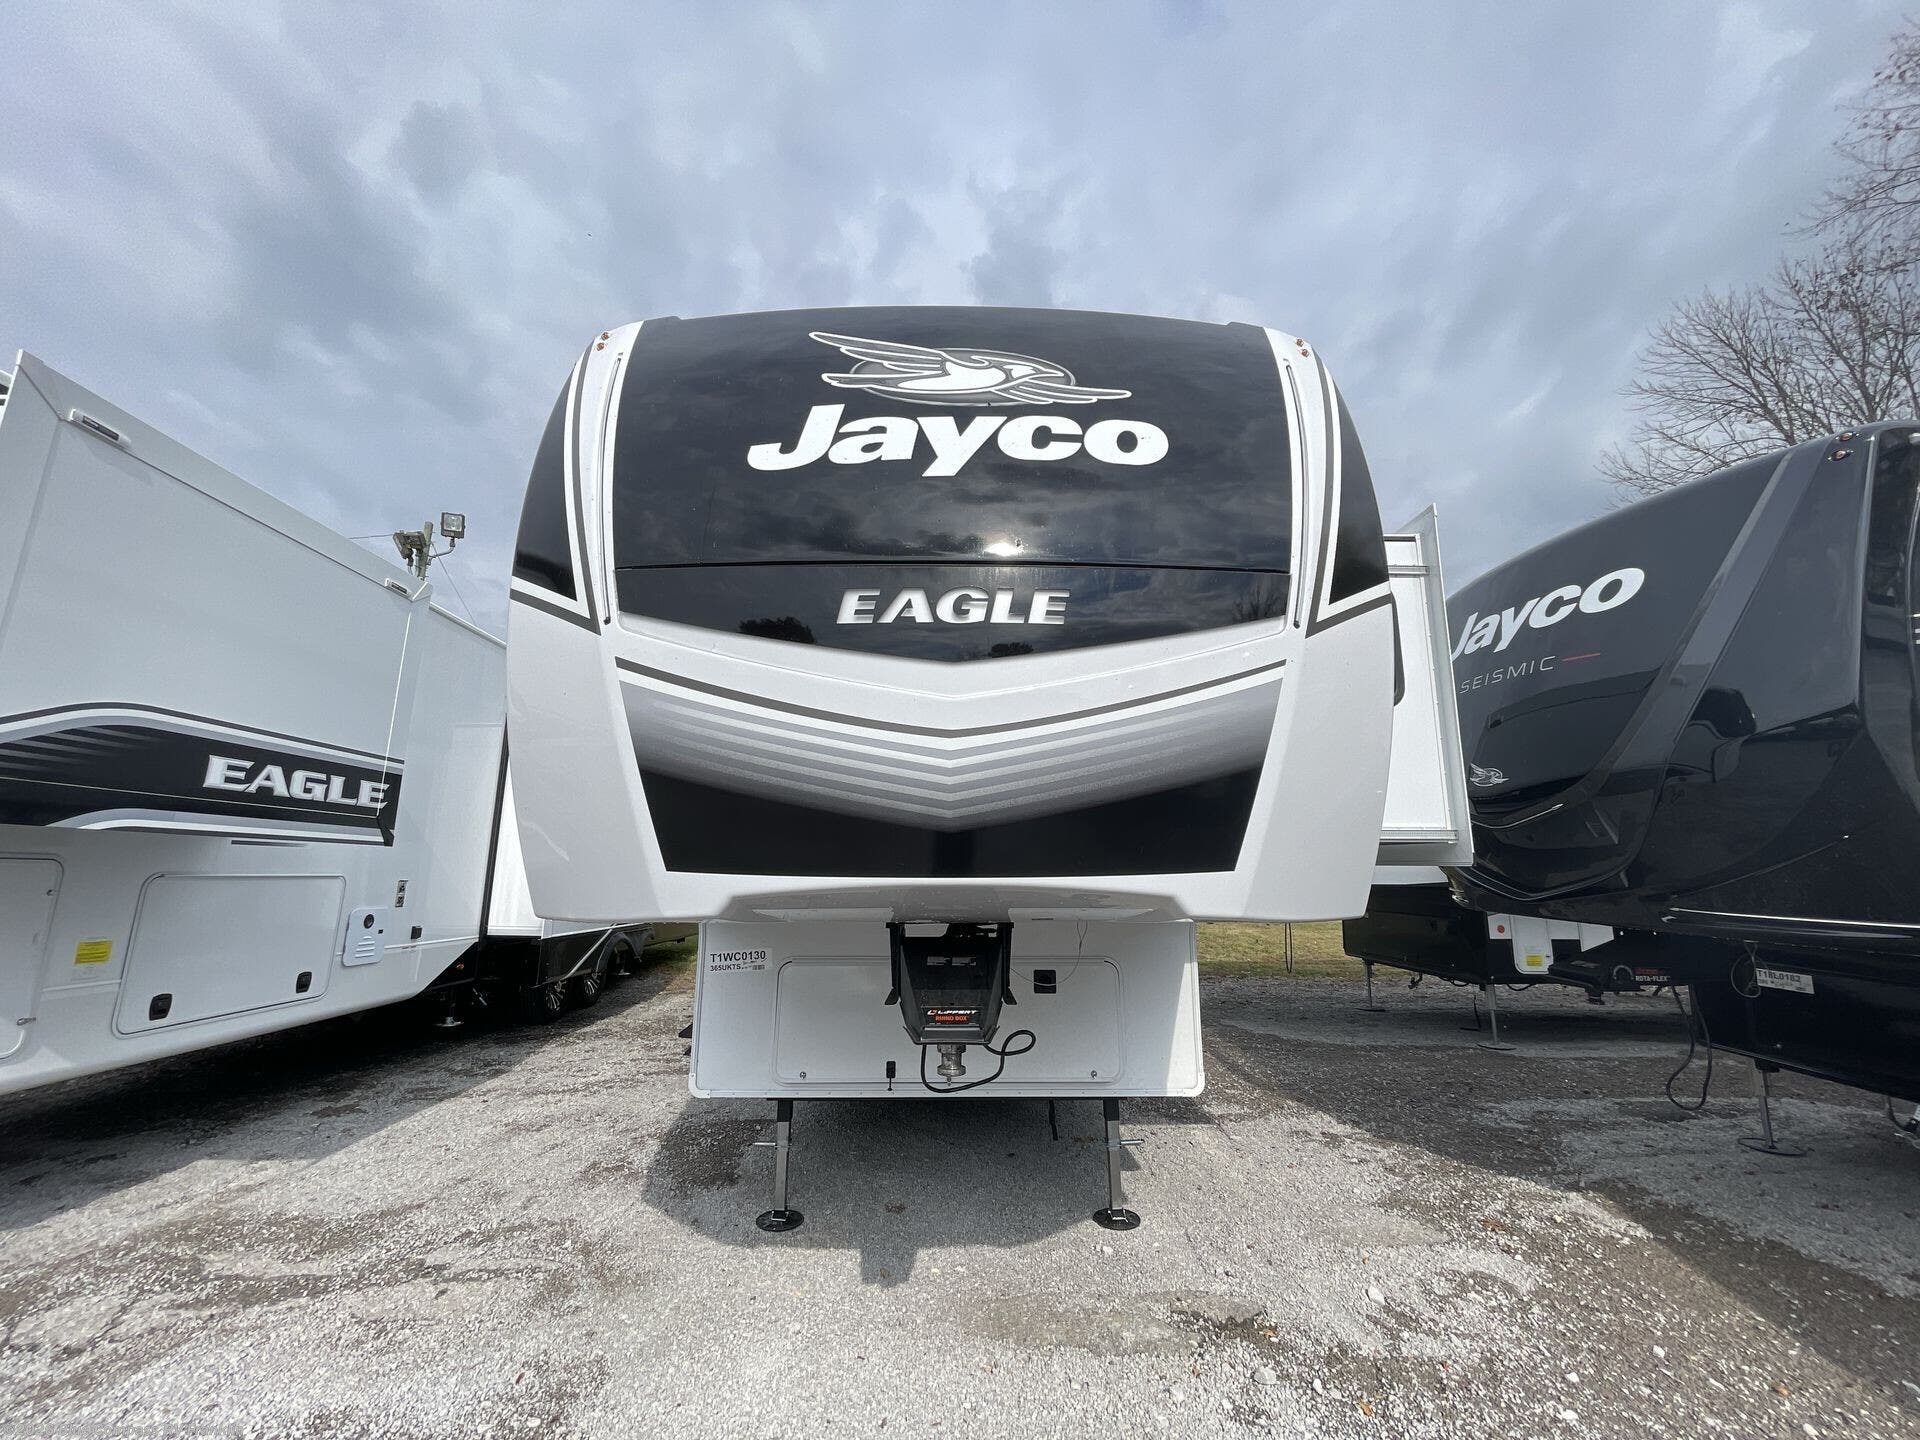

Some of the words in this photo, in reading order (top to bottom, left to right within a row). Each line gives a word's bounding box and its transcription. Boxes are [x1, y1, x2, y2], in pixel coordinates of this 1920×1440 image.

[747, 404, 1169, 477] Jayco
[836, 588, 1070, 625] EAGLE
[1450, 567, 1645, 663] Jayco
[1459, 655, 1556, 694] SEISMIC
[202, 754, 390, 809] EAGLE
[710, 950, 766, 962] T1WC0130
